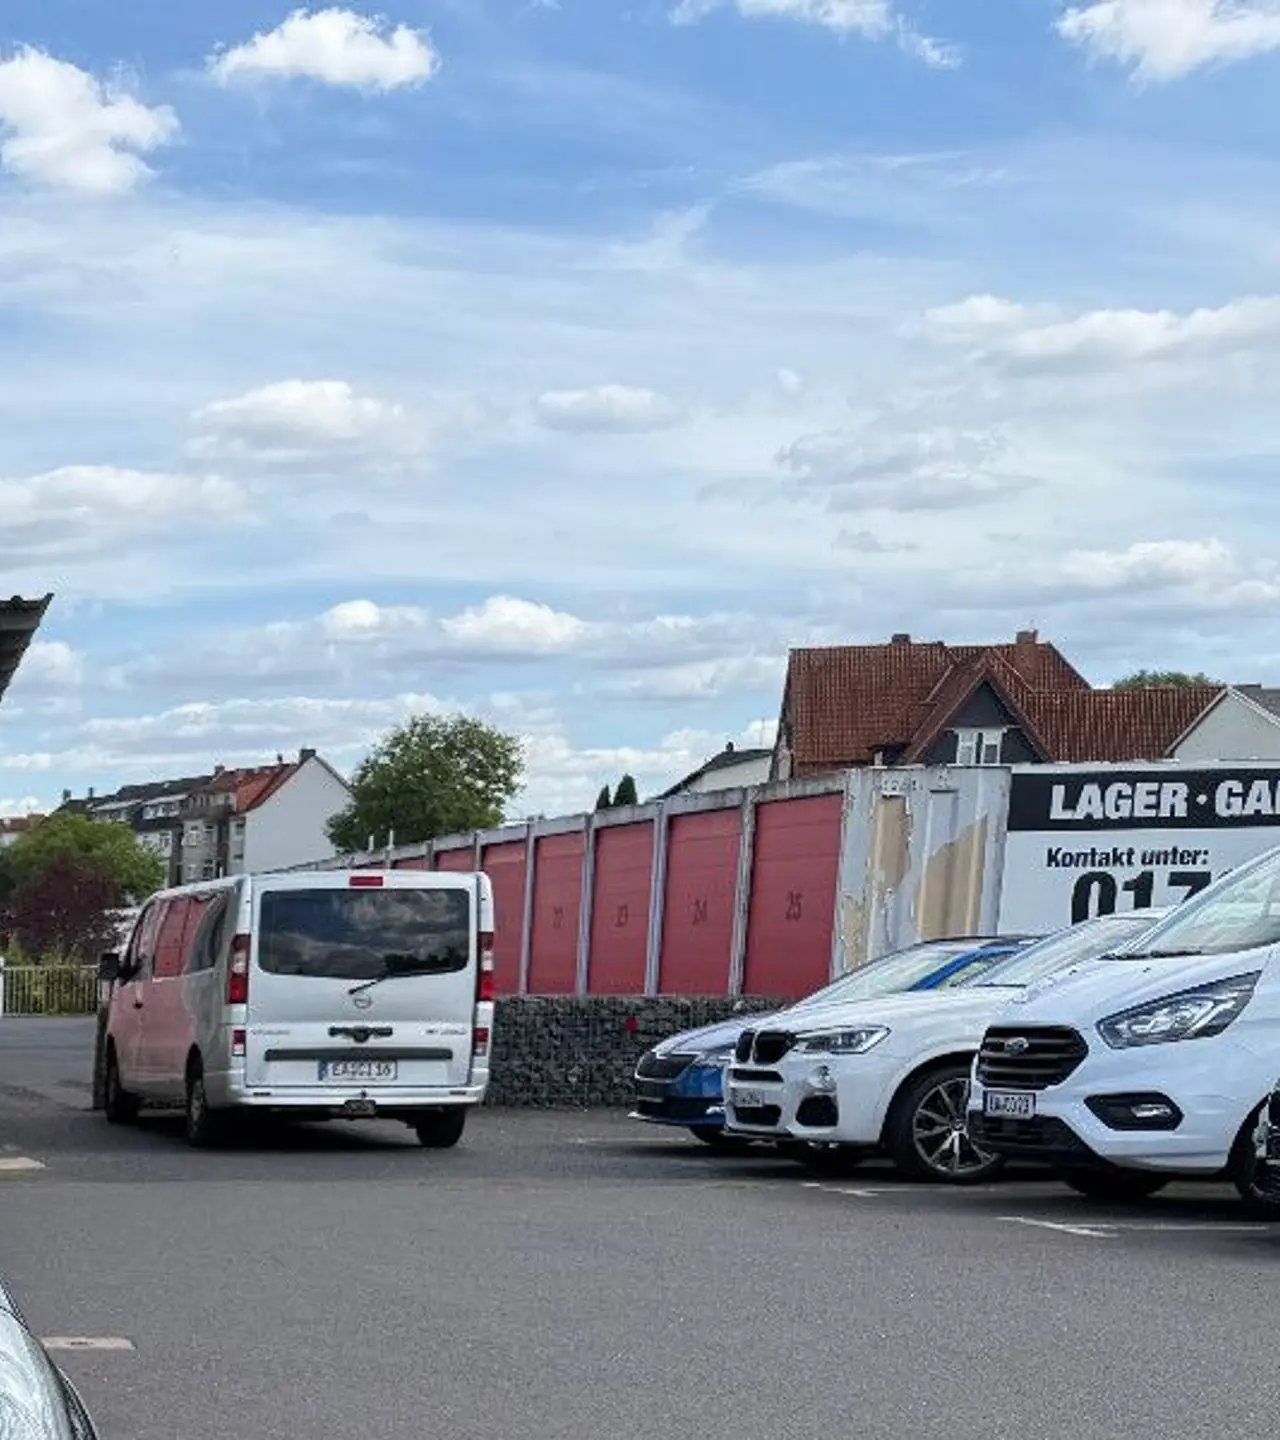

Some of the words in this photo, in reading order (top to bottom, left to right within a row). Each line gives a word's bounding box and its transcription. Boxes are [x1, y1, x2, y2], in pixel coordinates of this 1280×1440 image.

[1049, 782, 1190, 820] LAGER
[1214, 780, 1280, 817] GA
[1046, 847, 1135, 868] Kontakt
[1140, 847, 1210, 867] unter:
[785, 891, 803, 920] 25
[1071, 868, 1234, 925] 017
